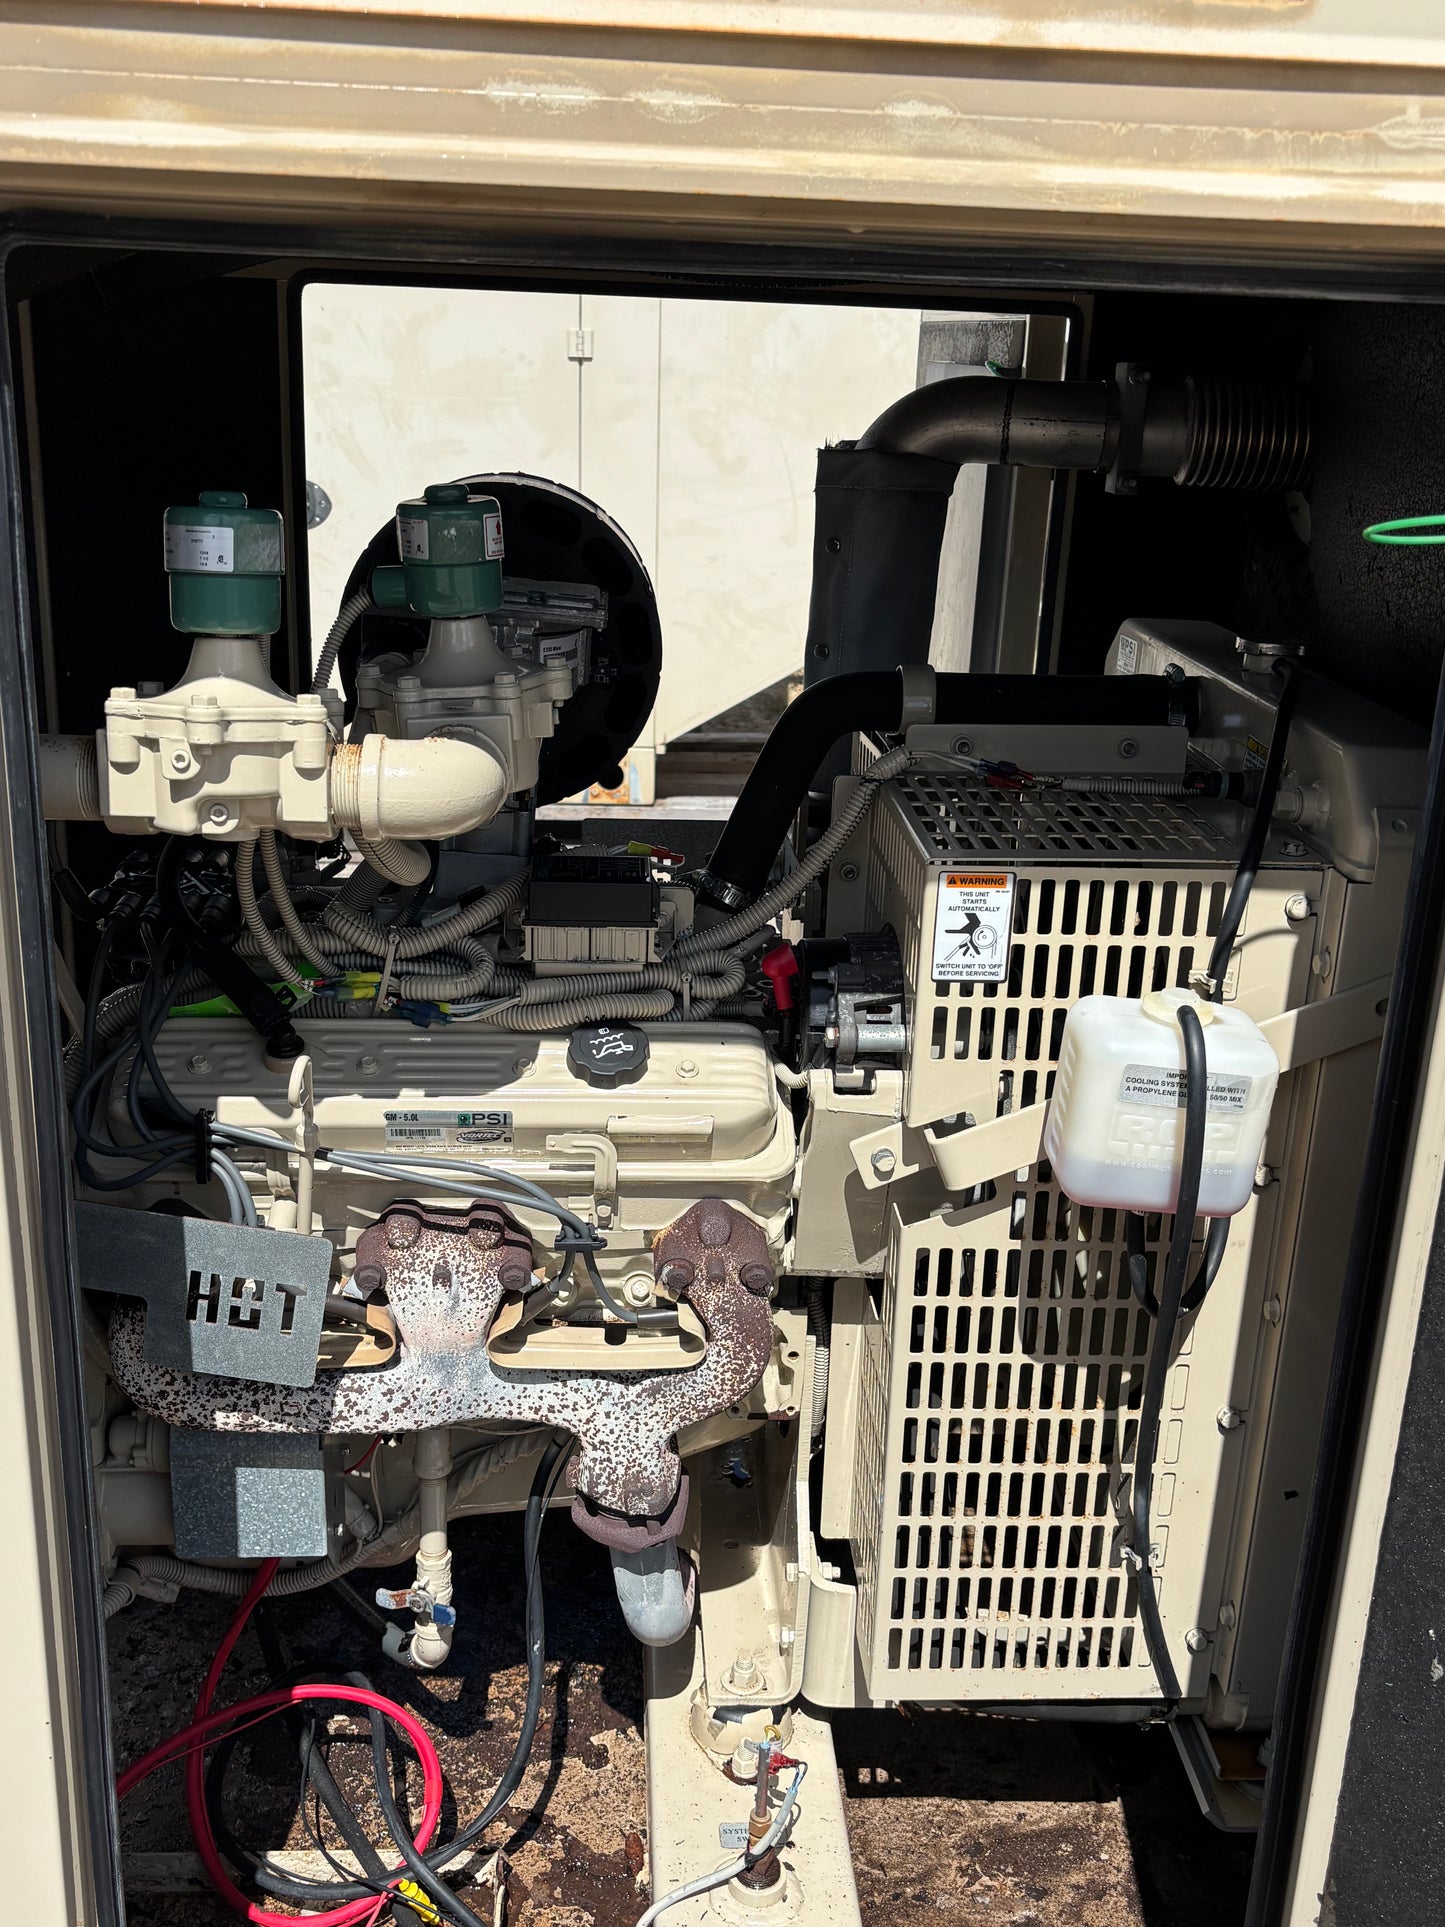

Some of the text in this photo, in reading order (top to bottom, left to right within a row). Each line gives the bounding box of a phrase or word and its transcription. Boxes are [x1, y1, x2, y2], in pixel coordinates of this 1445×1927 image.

[959, 877, 1005, 886] WARNING
[1125, 1076, 1160, 1087] COOLING
[1227, 1087, 1246, 1095] WITH
[1132, 1086, 1177, 1097] PROPYLENE
[1209, 1094, 1228, 1102] 50/50
[1228, 1095, 1243, 1103] MIX
[385, 1113, 397, 1122] GM
[403, 1113, 420, 1122] 5.0L
[471, 1113, 508, 1126] PSI
[186, 1270, 308, 1335] HOT
